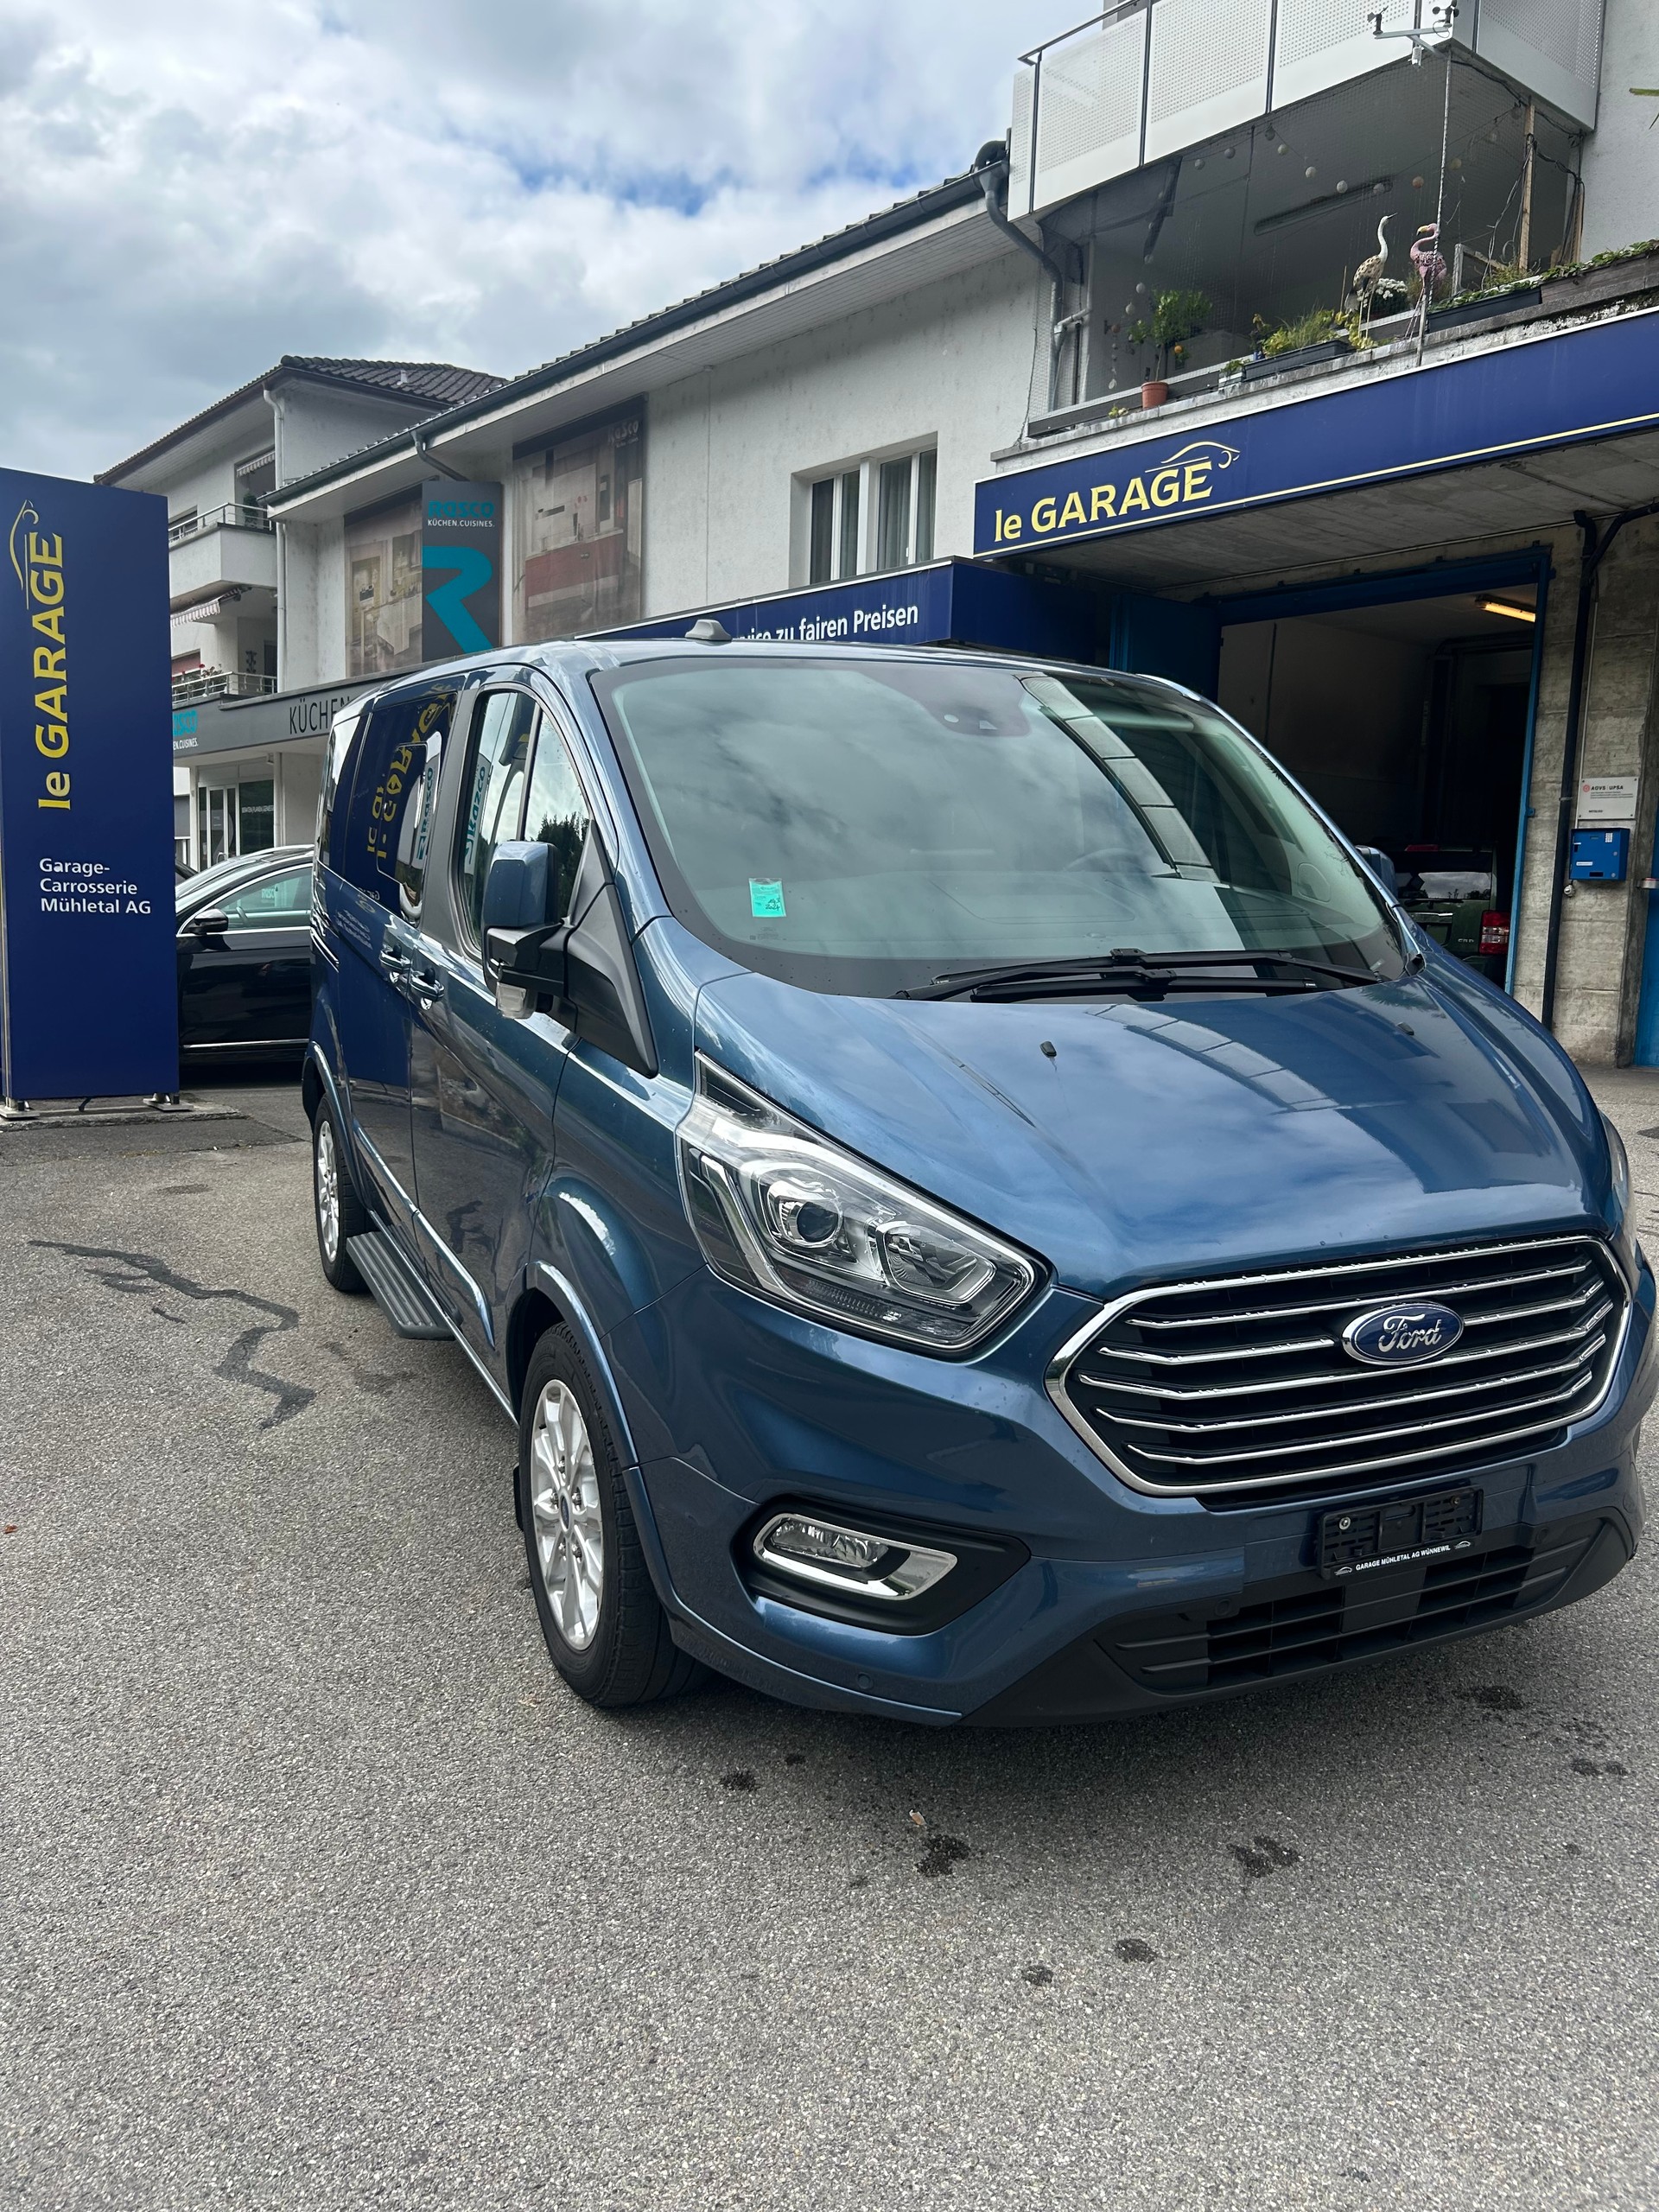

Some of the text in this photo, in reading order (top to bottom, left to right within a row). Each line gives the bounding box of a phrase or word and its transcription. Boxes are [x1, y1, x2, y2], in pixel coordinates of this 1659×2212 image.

[995, 461, 1213, 542] le GARAGE
[798, 616, 848, 640] fairen
[854, 604, 918, 634] Preisen
[29, 531, 71, 810] le GARAGE
[39, 858, 111, 877] Garage-
[40, 878, 137, 895] Carrosserie
[41, 898, 151, 914] Mühletal AG
[1378, 1313, 1442, 1352] Ford
[1355, 1560, 1381, 1571] GARAGE
[1382, 1553, 1411, 1565] MÜHLETAL
[1421, 1545, 1452, 1556] WÜNNEWIL
